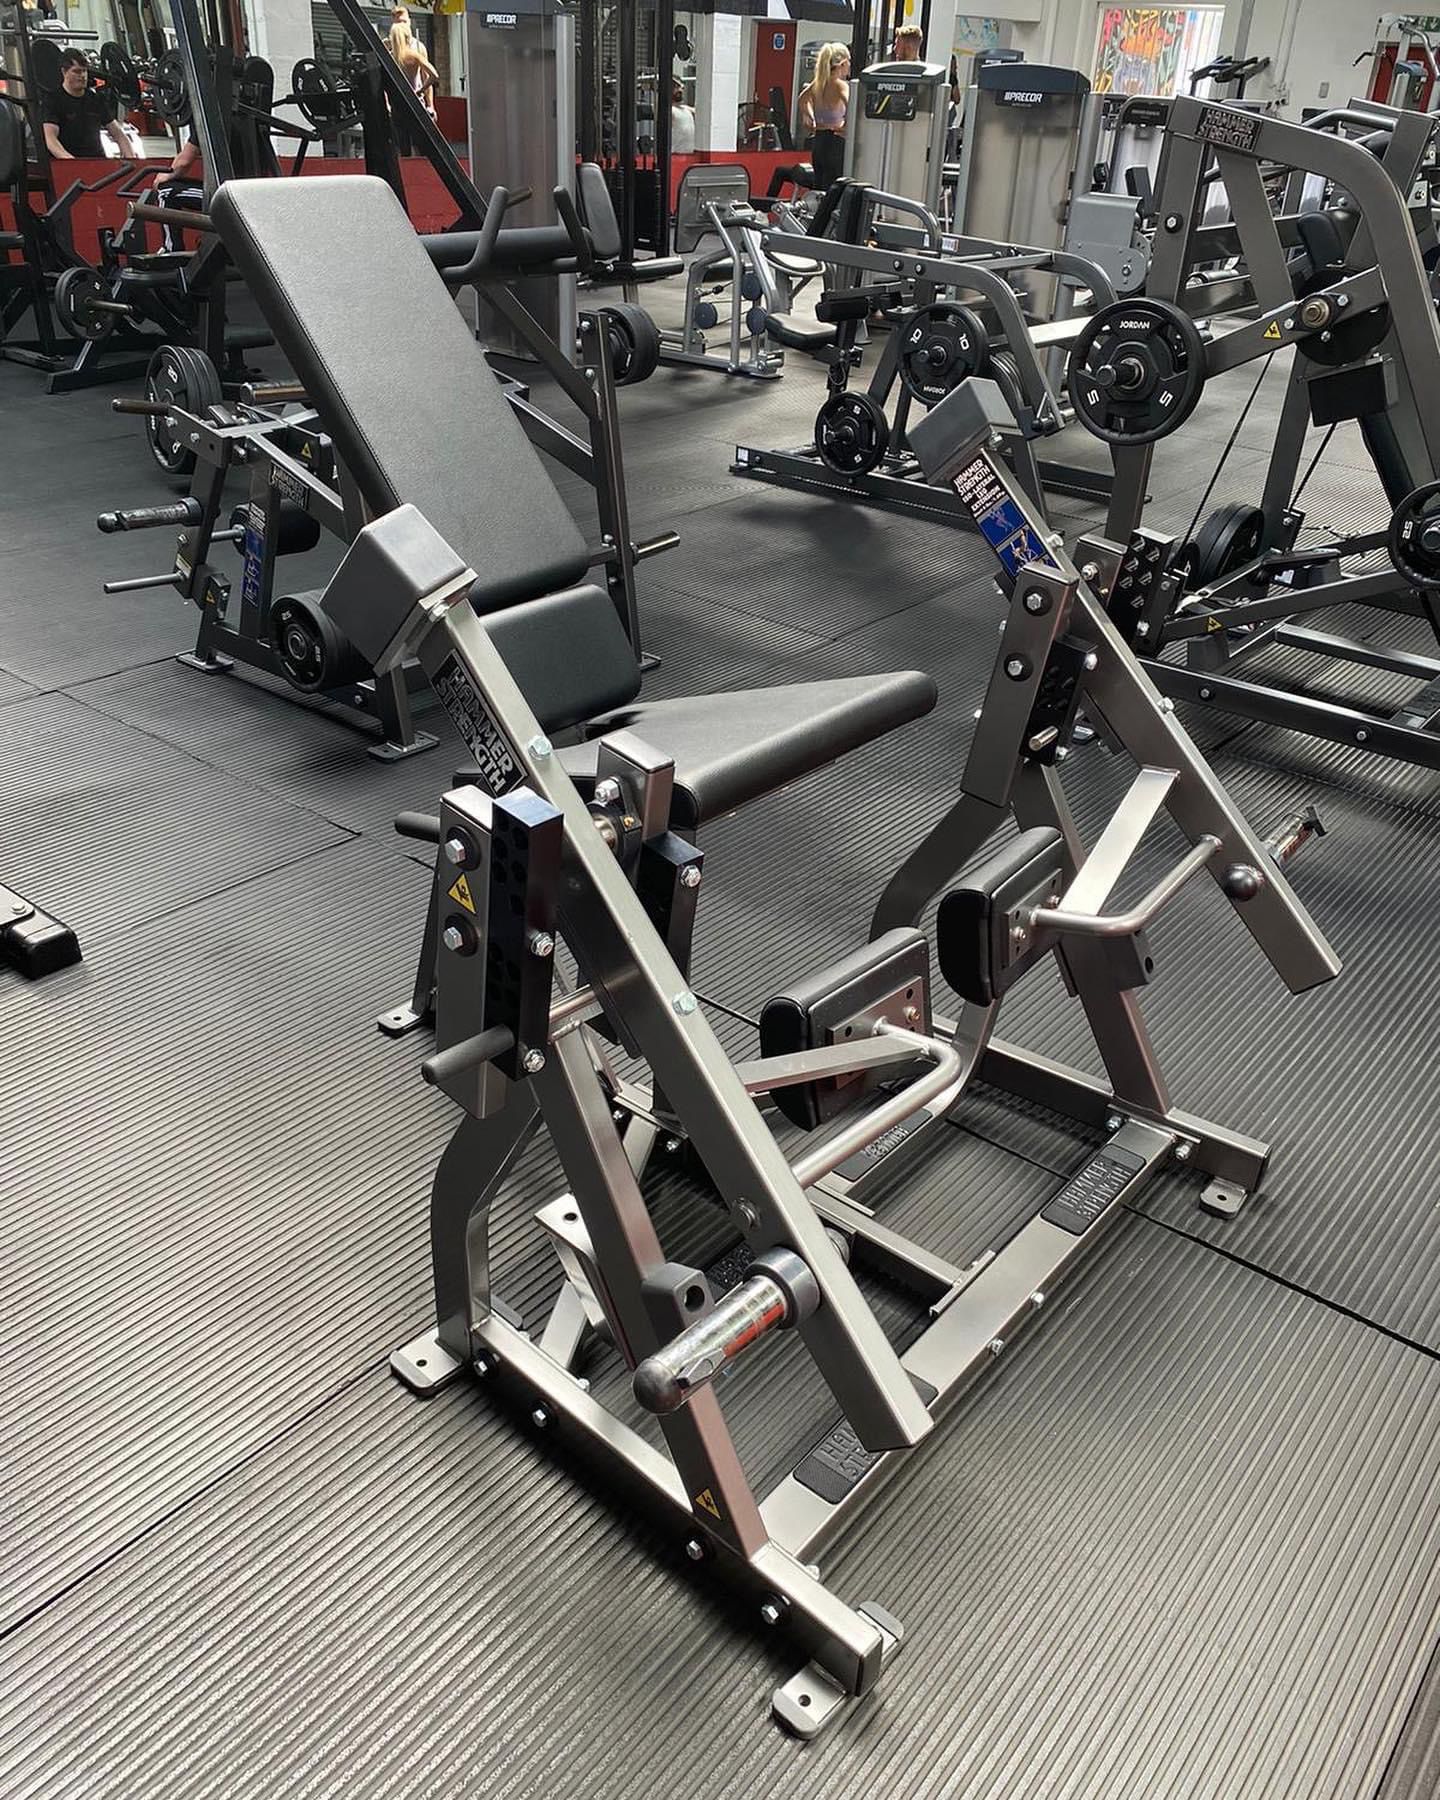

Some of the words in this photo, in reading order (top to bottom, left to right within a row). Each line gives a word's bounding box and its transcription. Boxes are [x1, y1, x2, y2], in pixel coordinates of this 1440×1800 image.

[1004, 91, 1043, 103] PRECOR
[1203, 109, 1254, 135] HAMMER
[1198, 125, 1253, 149] STRENGTH
[909, 328, 923, 344] 10
[1119, 320, 1151, 329] JORDAN
[959, 333, 970, 350] 10
[1087, 389, 1100, 406] 5
[1159, 390, 1174, 407] 5
[953, 459, 984, 488] HAMMER
[957, 464, 991, 497] STRENGTH
[448, 665, 514, 777] HAMMER
[436, 677, 507, 793] STRENGTH
[1058, 1160, 1110, 1208] HAMMER
[1075, 1165, 1133, 1221] STRENGTH
